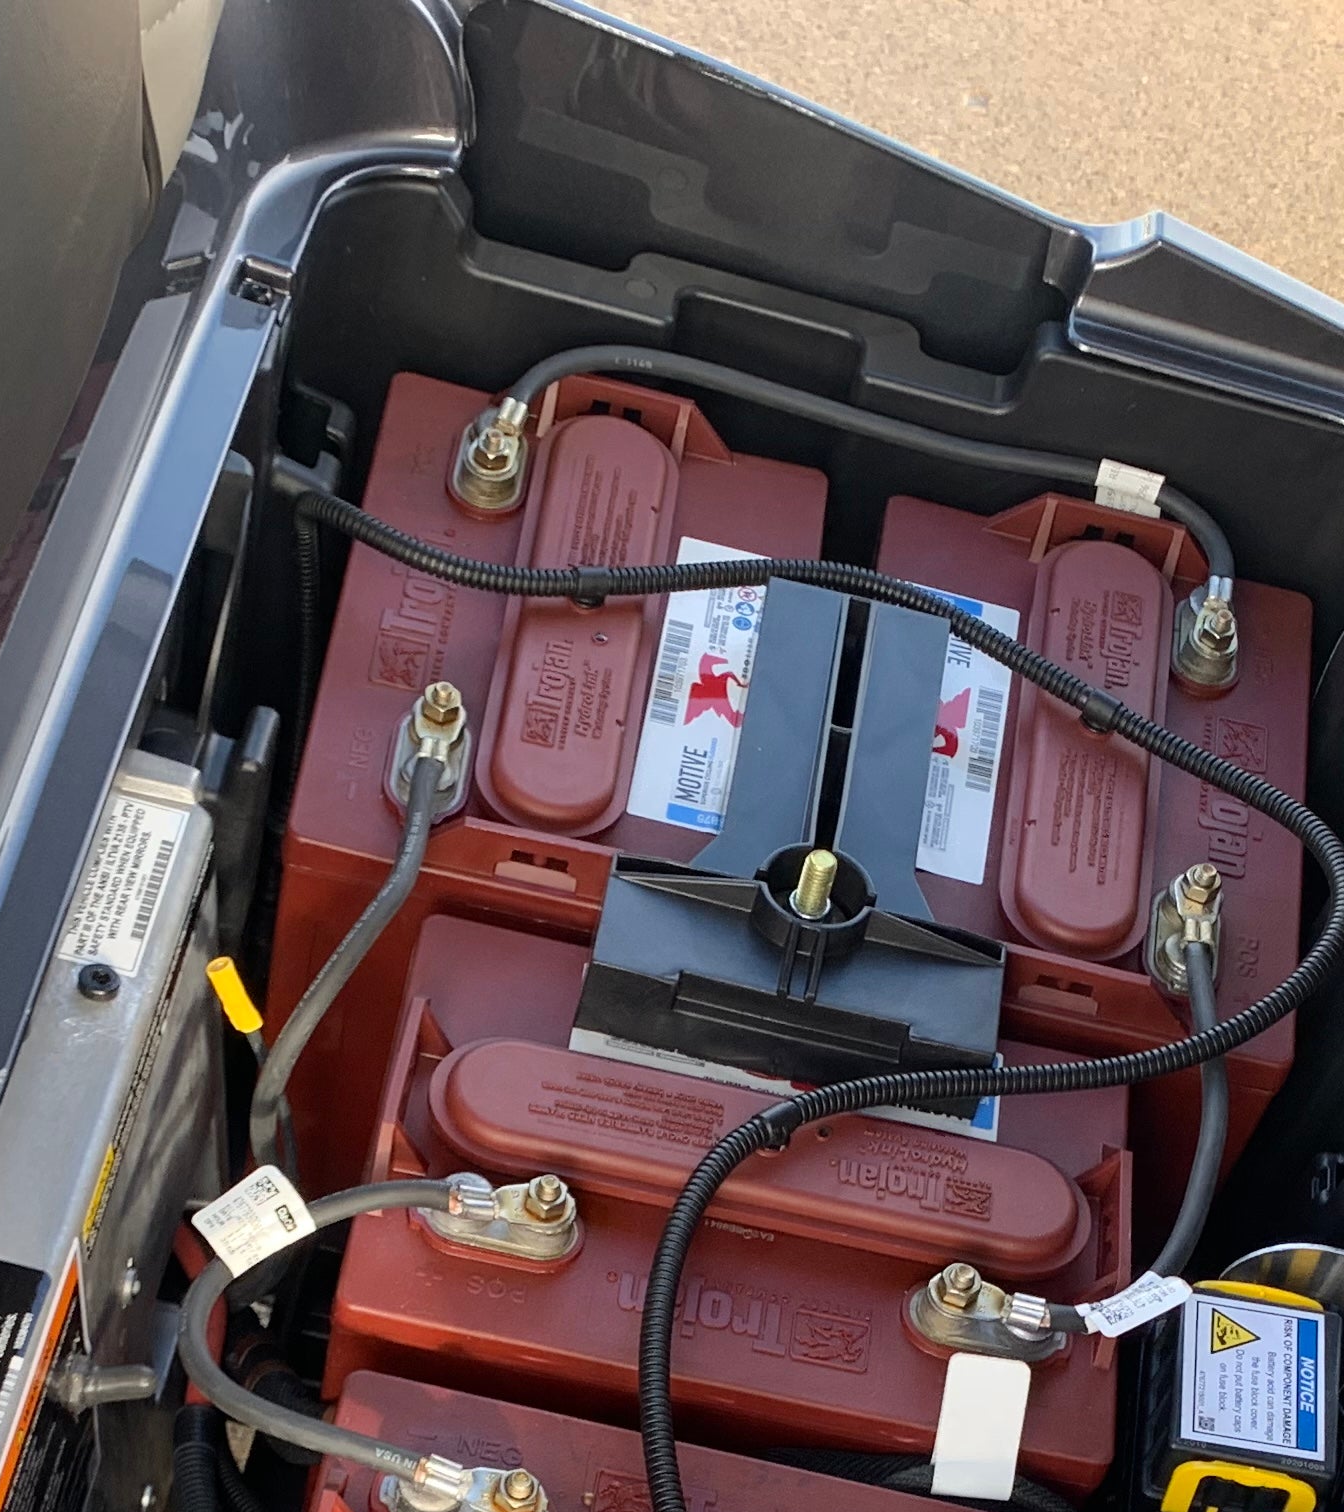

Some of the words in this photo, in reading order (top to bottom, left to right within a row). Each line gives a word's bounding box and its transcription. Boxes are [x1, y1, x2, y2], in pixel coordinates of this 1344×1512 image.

[526, 638, 573, 726] Trojan
[675, 746, 706, 802] MOTIVE
[87, 924, 106, 955] SAFETY
[100, 876, 121, 920] STANDARD
[115, 850, 130, 874] WHEN
[106, 918, 121, 939] WITH
[114, 893, 129, 915] REAR
[122, 870, 137, 891] VIEW
[74, 932, 89, 955] PART
[835, 1159, 944, 1209] Trojan
[618, 1275, 789, 1353] Trojn
[1282, 1318, 1292, 1339] RISK
[1235, 1348, 1244, 1359] Do
[1283, 1339, 1290, 1351] OF
[1219, 1362, 1228, 1373] on
[1234, 1361, 1243, 1373] not
[1250, 1356, 1260, 1368] the
[1264, 1350, 1276, 1377] Battery
[1218, 1373, 1228, 1390] fuse
[1231, 1373, 1242, 1386] put
[1250, 1370, 1260, 1385] fuse
[1266, 1379, 1276, 1394] acid
[1281, 1353, 1292, 1406] COMPONENT
[1298, 1355, 1314, 1414] NOTICE
[1232, 1387, 1243, 1413] battery
[1250, 1386, 1259, 1406] block
[1266, 1395, 1274, 1409] can
[1232, 1415, 1242, 1433] caps
[1264, 1411, 1275, 1441] damage
[1281, 1407, 1292, 1444] DAMAGE
[456, 1438, 524, 1465] NEG
